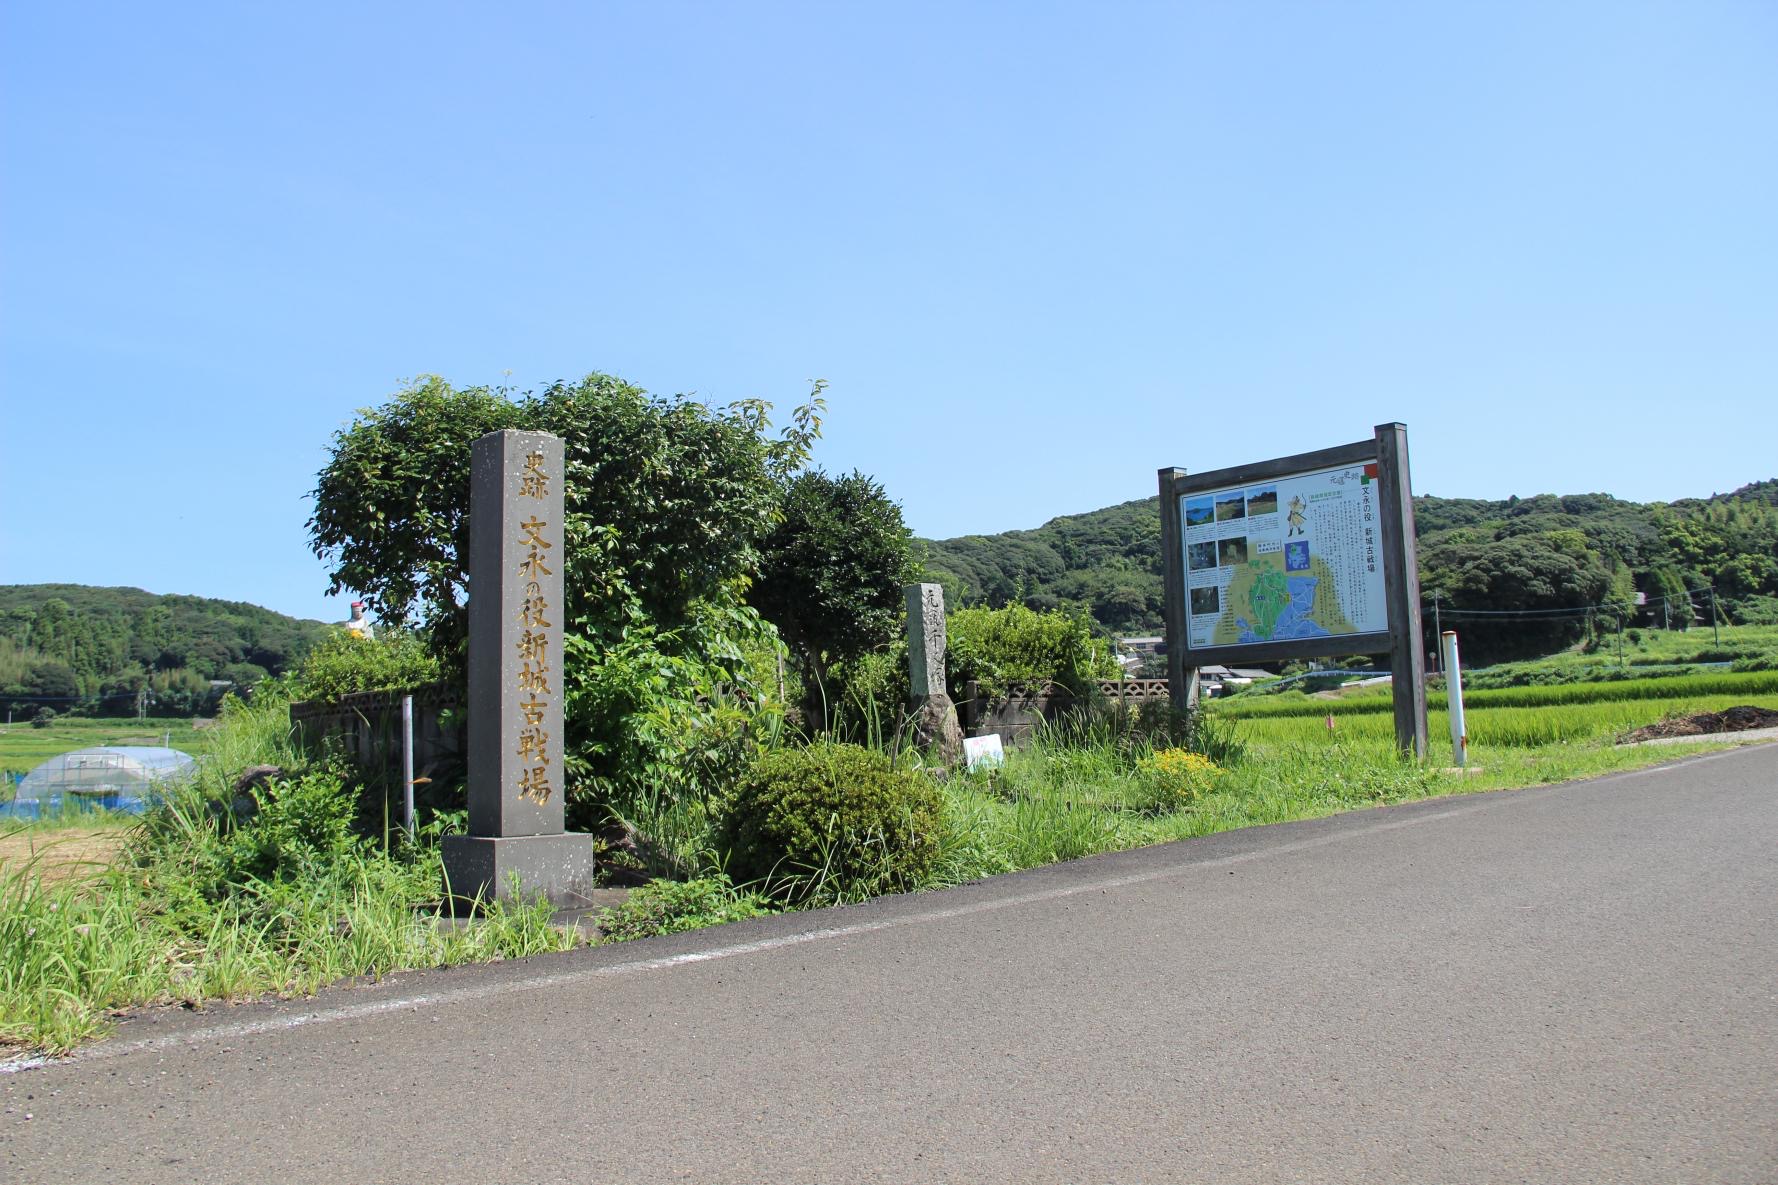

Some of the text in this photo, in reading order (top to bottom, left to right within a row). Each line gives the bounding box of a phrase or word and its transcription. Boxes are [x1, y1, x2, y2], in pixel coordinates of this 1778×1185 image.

[516, 451, 552, 807] 史跡 文永の役新城古戦場
[1362, 486, 1376, 573] 文永の役 新城古戦場
